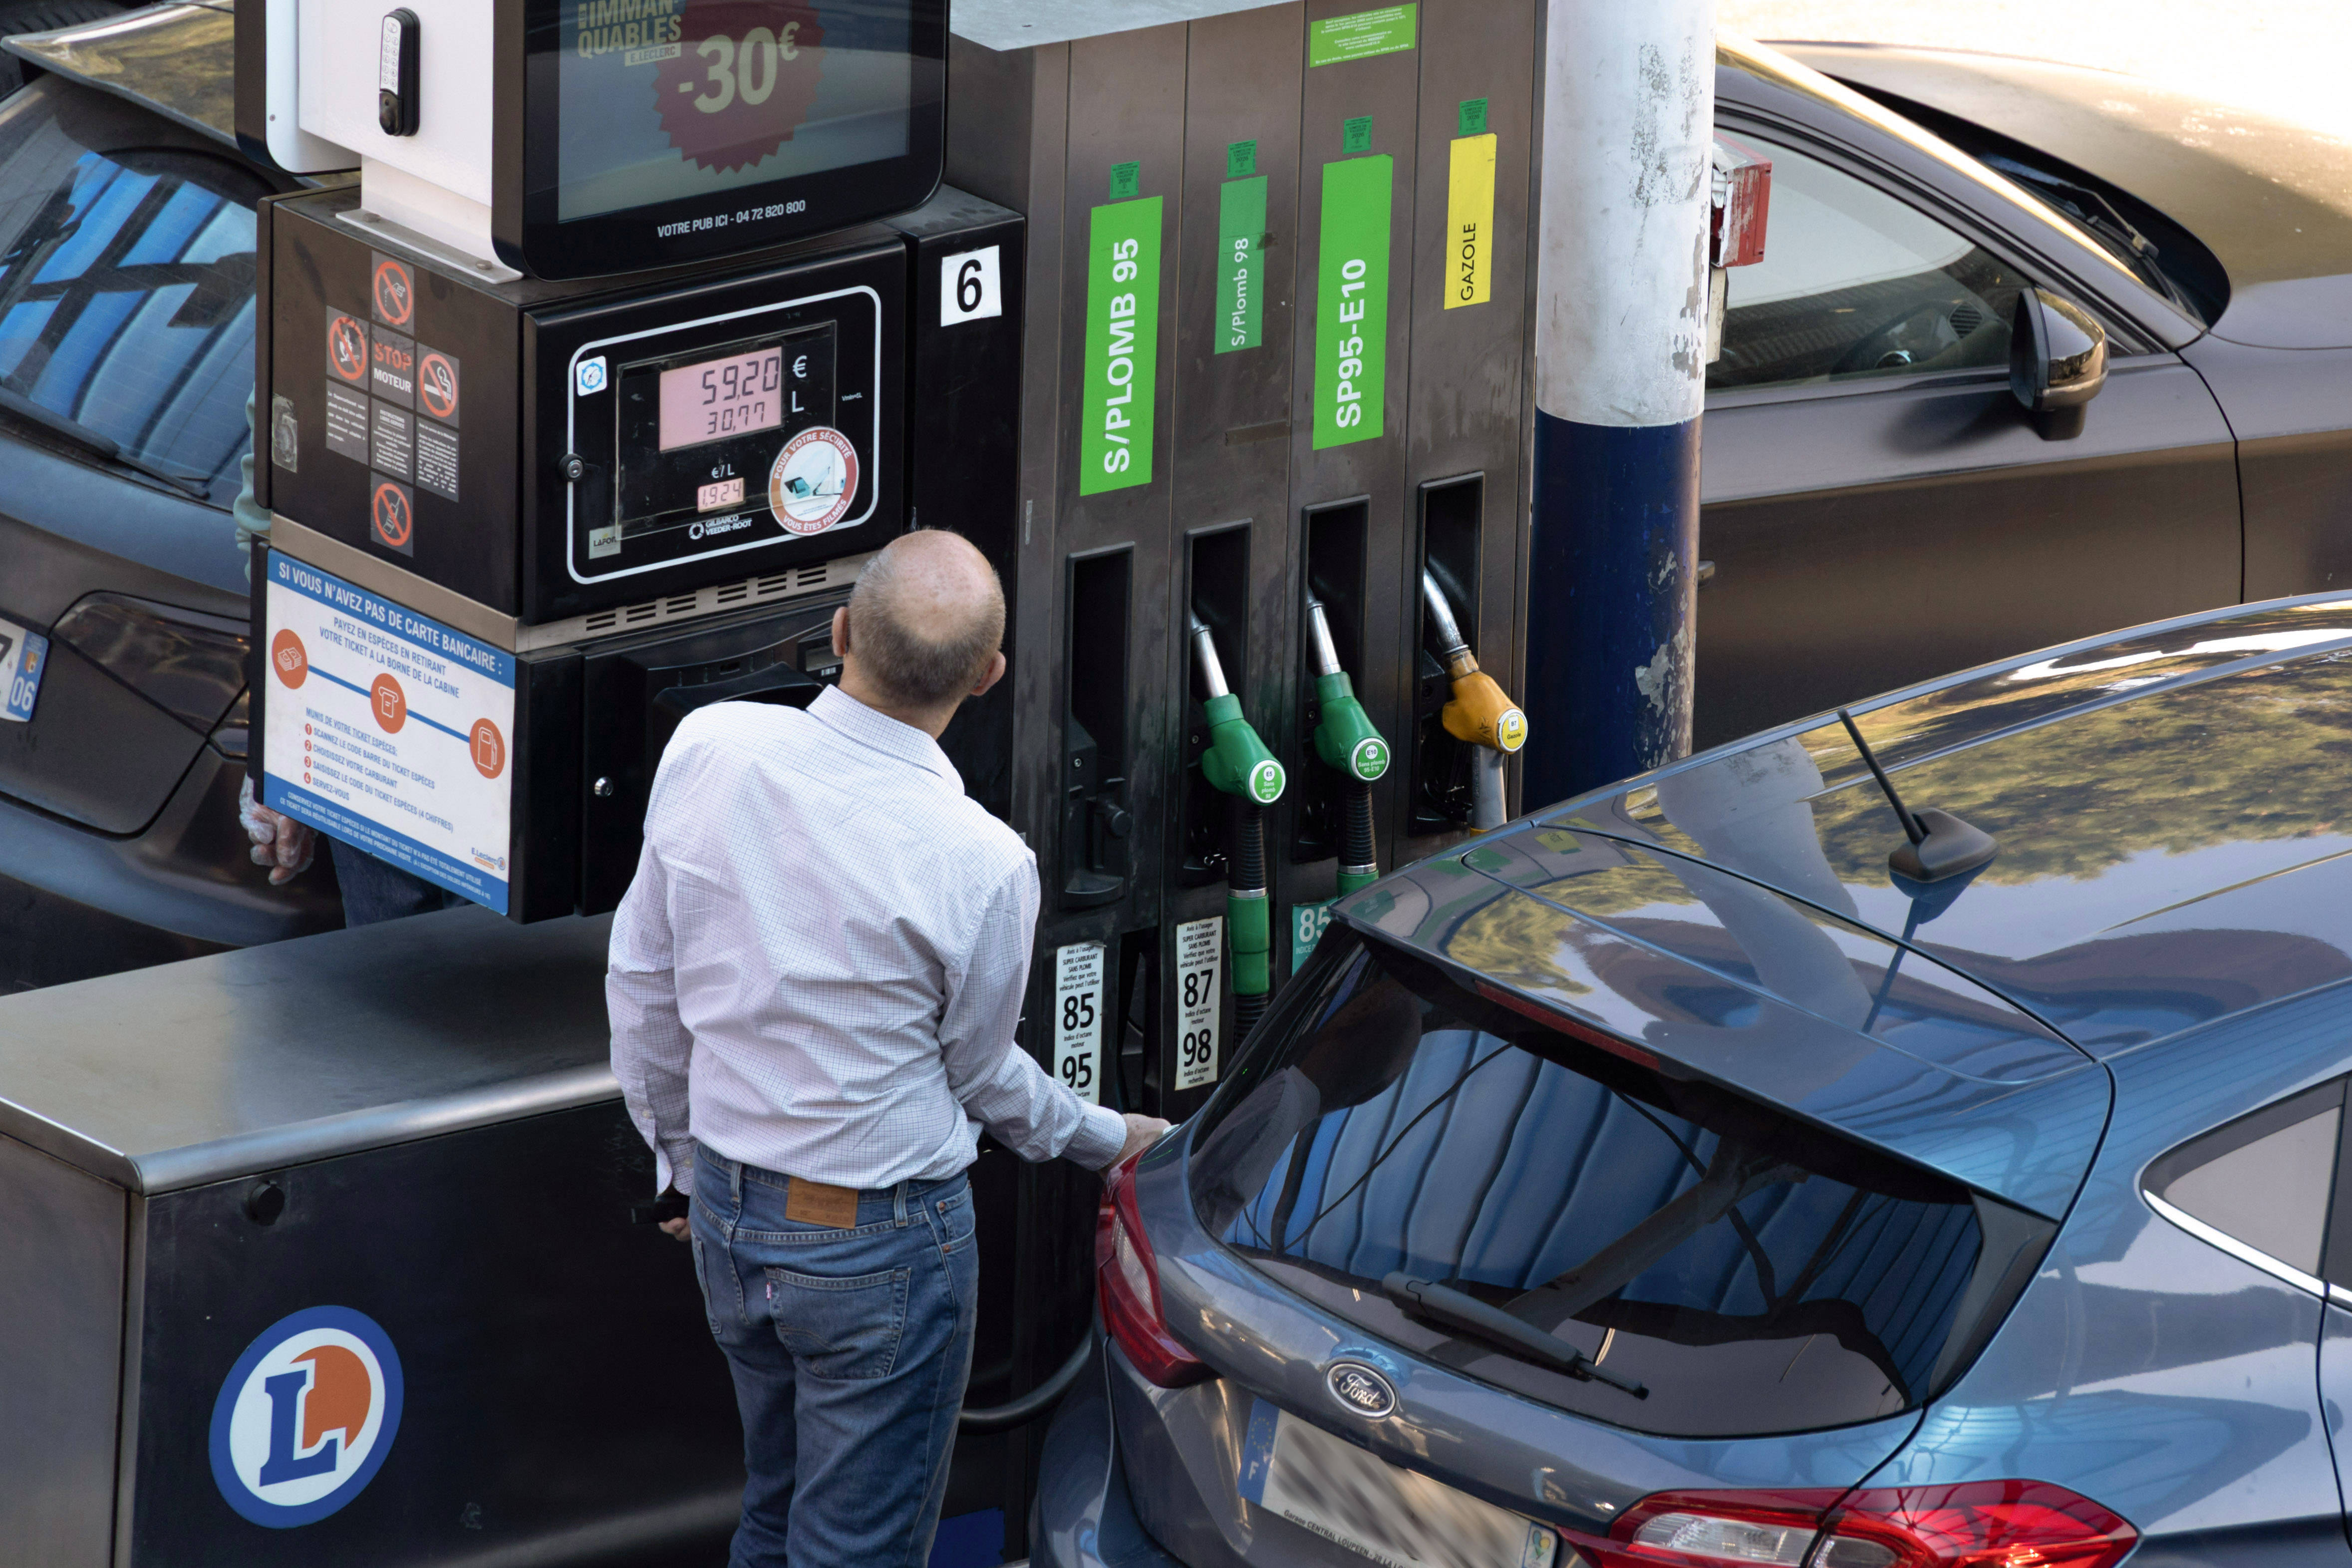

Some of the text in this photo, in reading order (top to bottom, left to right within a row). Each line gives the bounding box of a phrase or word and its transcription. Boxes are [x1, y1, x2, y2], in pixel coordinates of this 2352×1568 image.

[578, 14, 681, 59] QUABLES
[630, 46, 675, 62] E.LECLERC
[657, 221, 691, 237] VOTRE
[692, 217, 713, 232] PUB
[715, 214, 728, 227] ICI
[736, 210, 749, 223] 04
[751, 208, 763, 220] 72
[765, 204, 784, 218] 820
[786, 200, 806, 214] 800
[1460, 222, 1476, 302] GAZOLE
[957, 259, 982, 313] 6
[1231, 238, 1249, 346] S/Plomb 98
[374, 342, 412, 371] STOP
[1104, 238, 1139, 473] S/PLOMB 95
[1336, 258, 1367, 428] SP95-E10
[373, 367, 412, 393] MOTEUR
[702, 356, 780, 405] 59,20
[793, 355, 807, 378] €
[707, 401, 765, 435] 30,77
[792, 391, 805, 412] L
[774, 431, 853, 479] POUR VOTRE SÉCURITÉ
[702, 482, 742, 507] 1,924
[705, 515, 739, 528] GILBARCO
[705, 520, 752, 536] VEEDER-ROOT
[783, 515, 802, 530] VOUS
[803, 521, 822, 531] ÊTES
[823, 499, 847, 526] FILMÉS
[279, 561, 290, 581] SI
[292, 567, 322, 595] VOUS
[364, 599, 385, 623] PAS
[388, 609, 402, 630] DE
[405, 616, 439, 646] CARTE
[442, 632, 495, 672] BANCAIRE
[319, 626, 342, 646] VOTRE
[344, 637, 367, 657] TICKET
[376, 651, 385, 665] LA
[387, 656, 410, 676] BORNE
[412, 667, 421, 681] DE
[424, 672, 432, 686] LA
[434, 677, 459, 698] CABINE
[334, 617, 446, 676] PAYEZ EN ESPÈCES EN RETIRANT
[10, 676, 35, 712] 06
[306, 707, 323, 723] MUNIS
[325, 715, 332, 727] DE
[333, 719, 350, 735] VOTRE
[352, 727, 370, 744] TICKET
[313, 743, 344, 765] CHOISISSEZ
[346, 758, 362, 773] VOTRE
[365, 767, 397, 789] CARBURANT
[314, 727, 338, 745] SCANNEZ
[339, 739, 345, 749] LE
[347, 742, 361, 756] CODE
[363, 749, 380, 765] BARRE
[382, 758, 390, 769] DU
[392, 762, 409, 778] TICKET
[411, 769, 434, 789] ESPÈCES
[312, 777, 349, 801] SERVEZ-VOUS
[313, 760, 340, 780] SAISISSEZ
[341, 773, 347, 783] LE
[349, 777, 363, 790] CODE
[365, 784, 372, 795] DU
[374, 788, 392, 803] TICKET
[394, 795, 417, 815] ESPÈCES
[425, 811, 453, 834] CHIFFRES)
[1194, 930, 1216, 940] CARBURANT
[1299, 906, 1331, 942] 85
[1075, 953, 1098, 962] CARBURANT
[1296, 944, 1311, 954] INDICE
[1184, 968, 1212, 1008] 87
[1063, 991, 1094, 1033] 85
[1183, 1027, 1211, 1068] 98
[1062, 1050, 1092, 1093] 95
[1340, 1373, 1380, 1406] Ford
[1248, 1461, 1259, 1481] F
[1284, 1509, 1306, 1526] Garage
[1307, 1521, 1336, 1541] CENTRAL
[1374, 1554, 1382, 1563] 28
